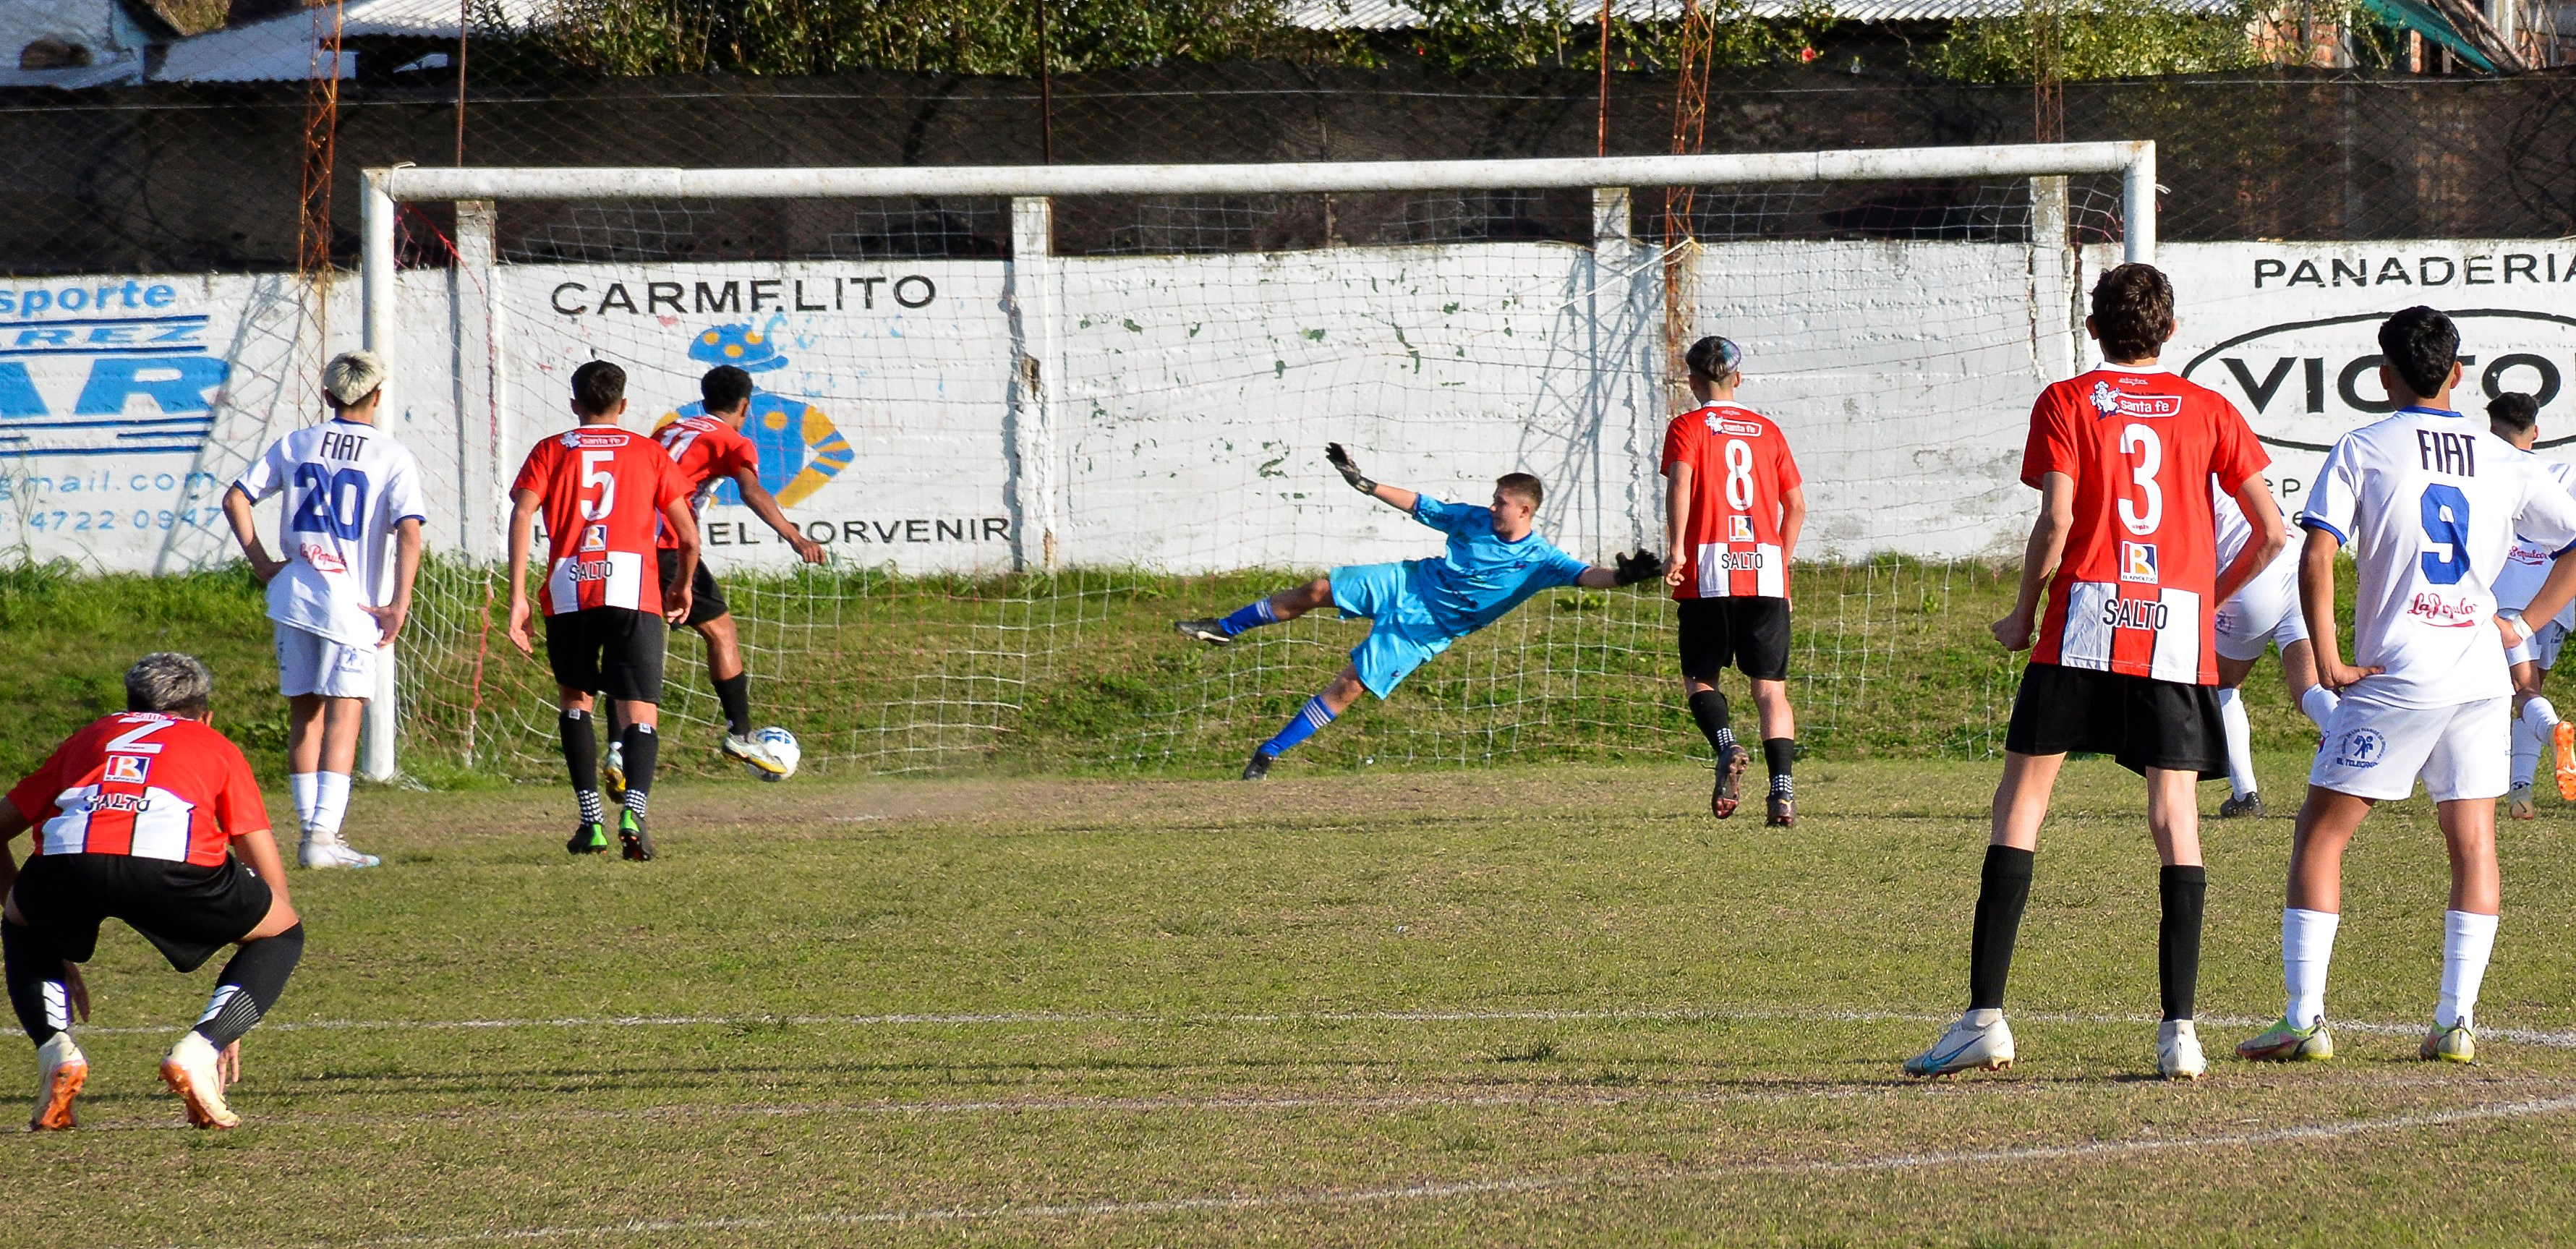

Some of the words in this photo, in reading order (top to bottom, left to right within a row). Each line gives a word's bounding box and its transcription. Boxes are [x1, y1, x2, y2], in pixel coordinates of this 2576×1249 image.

[550, 275, 937, 315] CARMELITO
[0, 325, 205, 346] REZ
[2219, 351, 2576, 415] VICO
[2120, 399, 2152, 413] santa
[2155, 400, 2170, 412] fe
[320, 431, 369, 462] FIAT
[2416, 429, 2475, 477] FIAT
[581, 450, 615, 521] 5
[1725, 438, 1754, 511] 8
[2117, 423, 2162, 536] 3
[293, 462, 370, 542] 20
[30, 509, 116, 533] 4722
[2421, 483, 2470, 585] 9
[568, 560, 613, 582] SALTO
[1721, 553, 1763, 569] SALTO
[2102, 598, 2168, 630] SALTO
[2407, 592, 2429, 615] La
